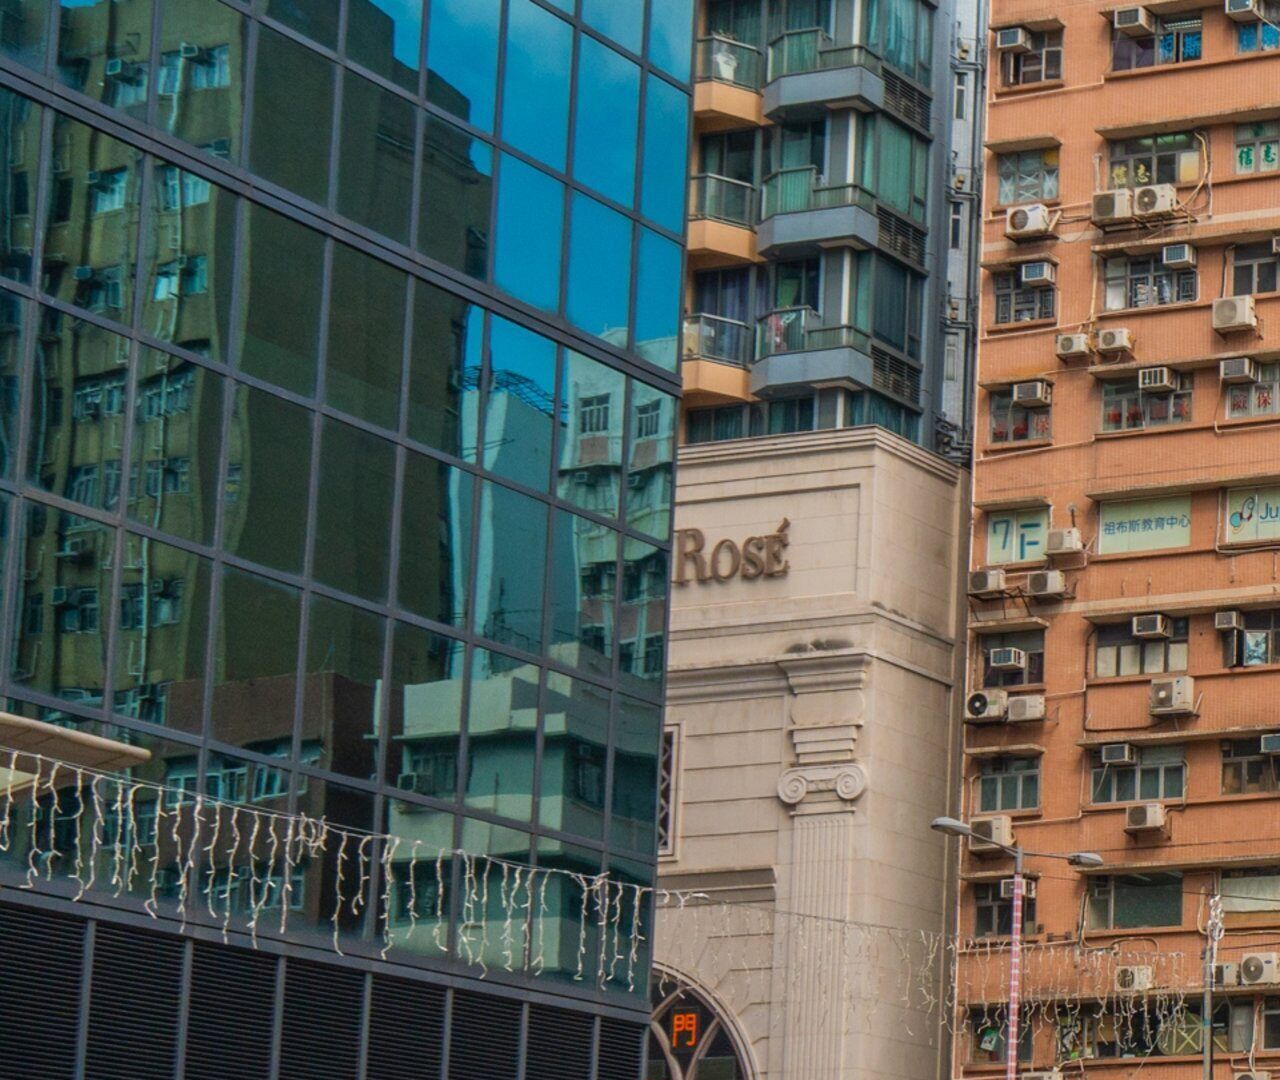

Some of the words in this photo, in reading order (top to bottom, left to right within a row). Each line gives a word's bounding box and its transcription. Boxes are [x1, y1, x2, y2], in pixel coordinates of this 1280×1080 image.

[1104, 514, 1191, 535] 祖布斯教育中心
